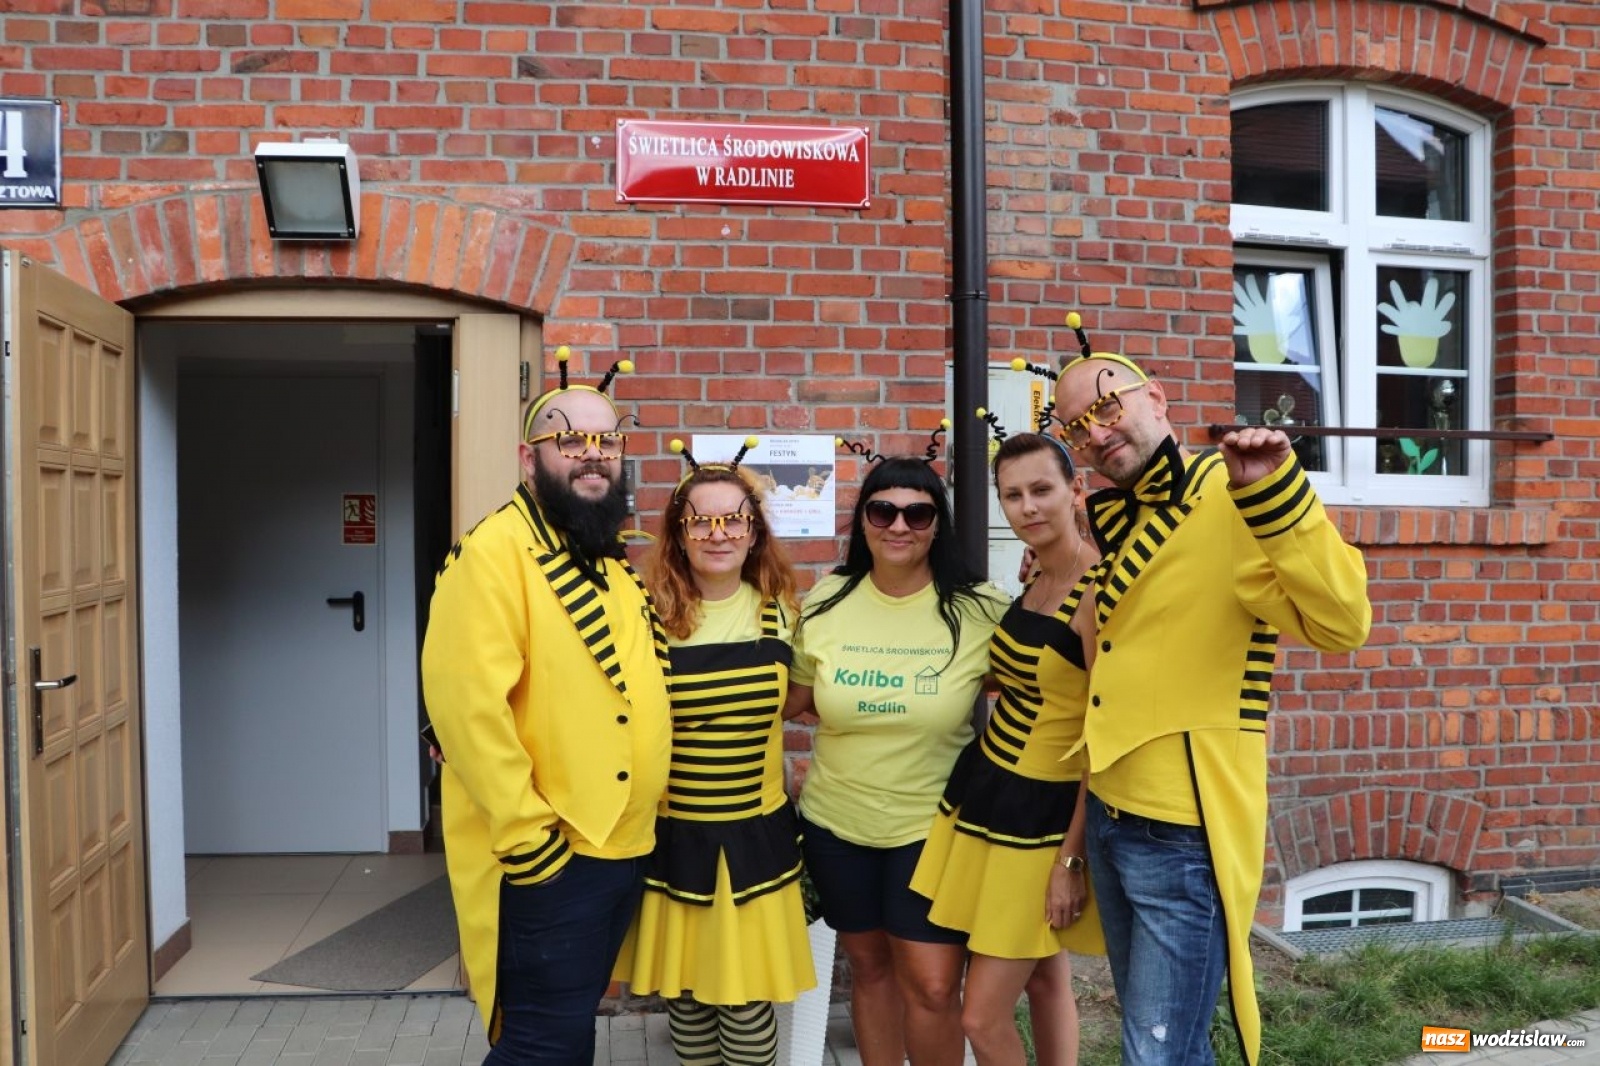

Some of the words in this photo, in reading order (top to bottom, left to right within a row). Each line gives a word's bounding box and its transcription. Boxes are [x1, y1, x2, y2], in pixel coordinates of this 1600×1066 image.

[0, 110, 28, 178] 4
[629, 132, 719, 157] ŚWIETLICA
[723, 134, 860, 162] ŚRODOWISKOWA
[696, 167, 712, 187] W
[715, 167, 795, 188] RADLINIE
[769, 449, 796, 457] FESTYN
[834, 667, 904, 688] Koliba
[858, 700, 906, 714] Radlin
